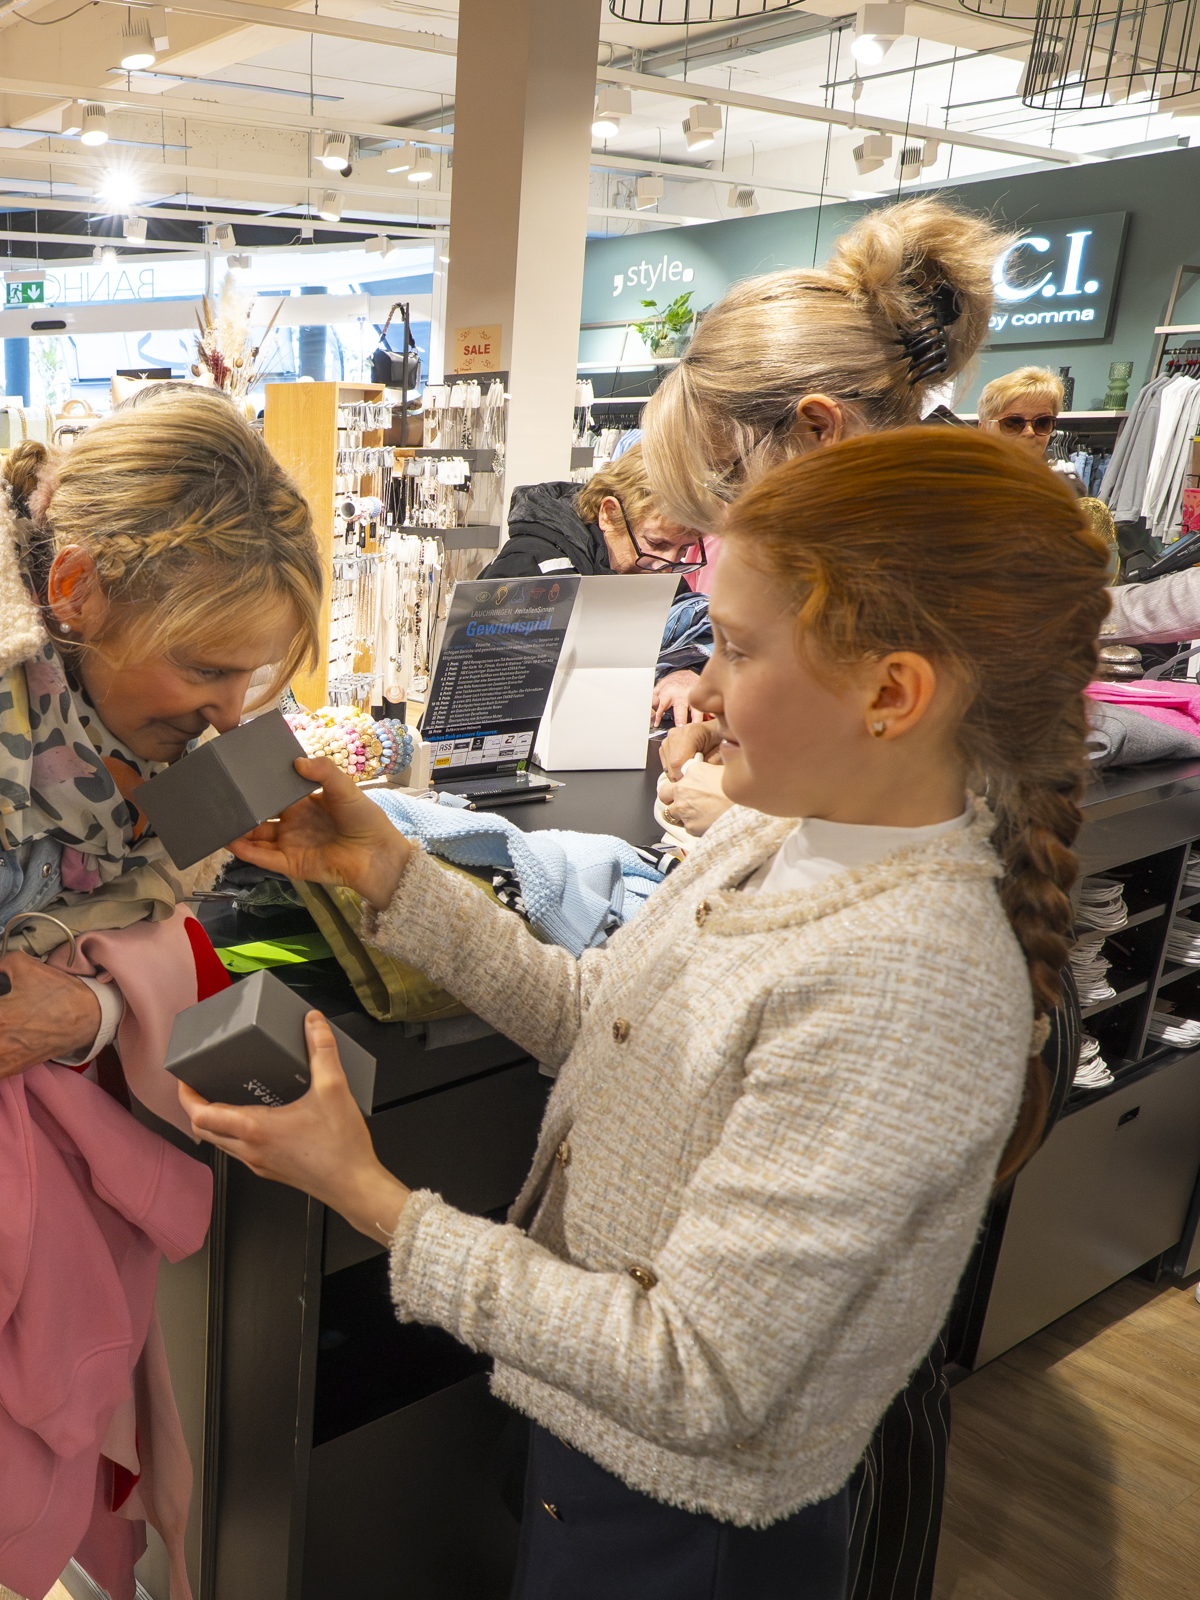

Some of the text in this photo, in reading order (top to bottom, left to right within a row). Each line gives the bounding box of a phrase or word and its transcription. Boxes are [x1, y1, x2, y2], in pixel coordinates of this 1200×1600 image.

[1011, 308, 1095, 326] comma
[463, 343, 491, 356] SALE
[470, 608, 513, 618] LAUCHRINGEN
[466, 616, 553, 637] Gewinnspiel
